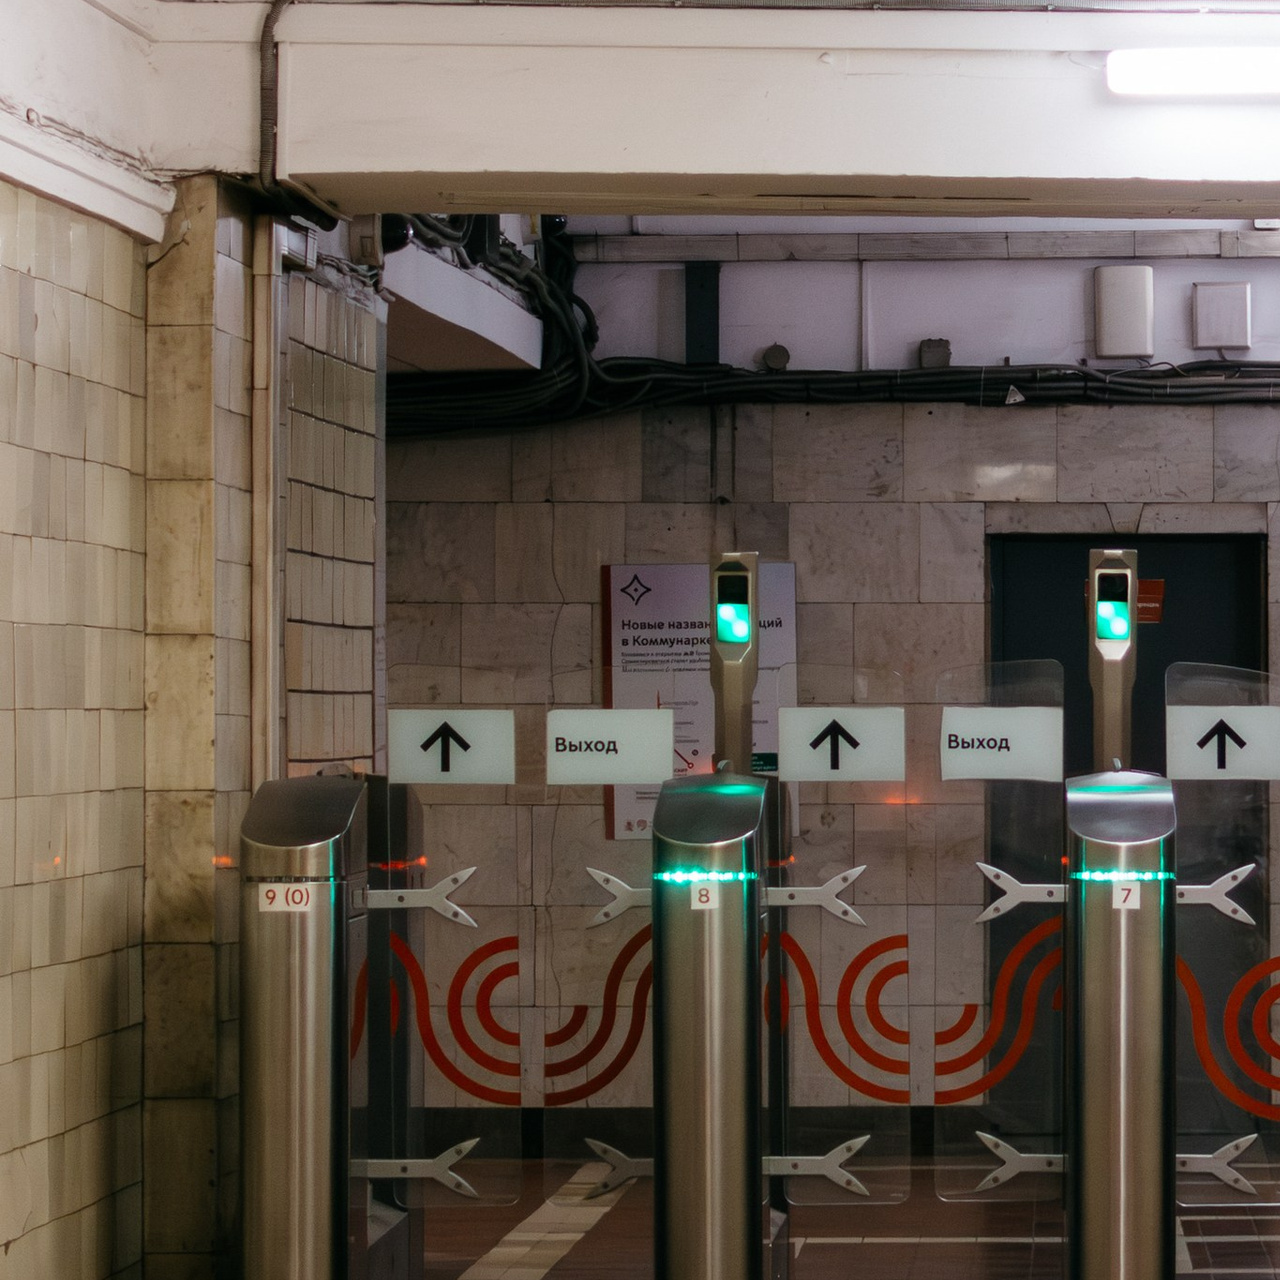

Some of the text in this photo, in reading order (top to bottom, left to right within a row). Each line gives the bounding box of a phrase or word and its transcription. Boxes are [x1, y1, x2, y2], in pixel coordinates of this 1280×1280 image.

[621, 619, 711, 630] Новые назван
[621, 638, 629, 647] в
[555, 736, 618, 755] Выход
[948, 733, 1010, 752] Выход
[265, 888, 276, 906] 9
[698, 887, 710, 904] 8
[1121, 887, 1132, 904] 7
